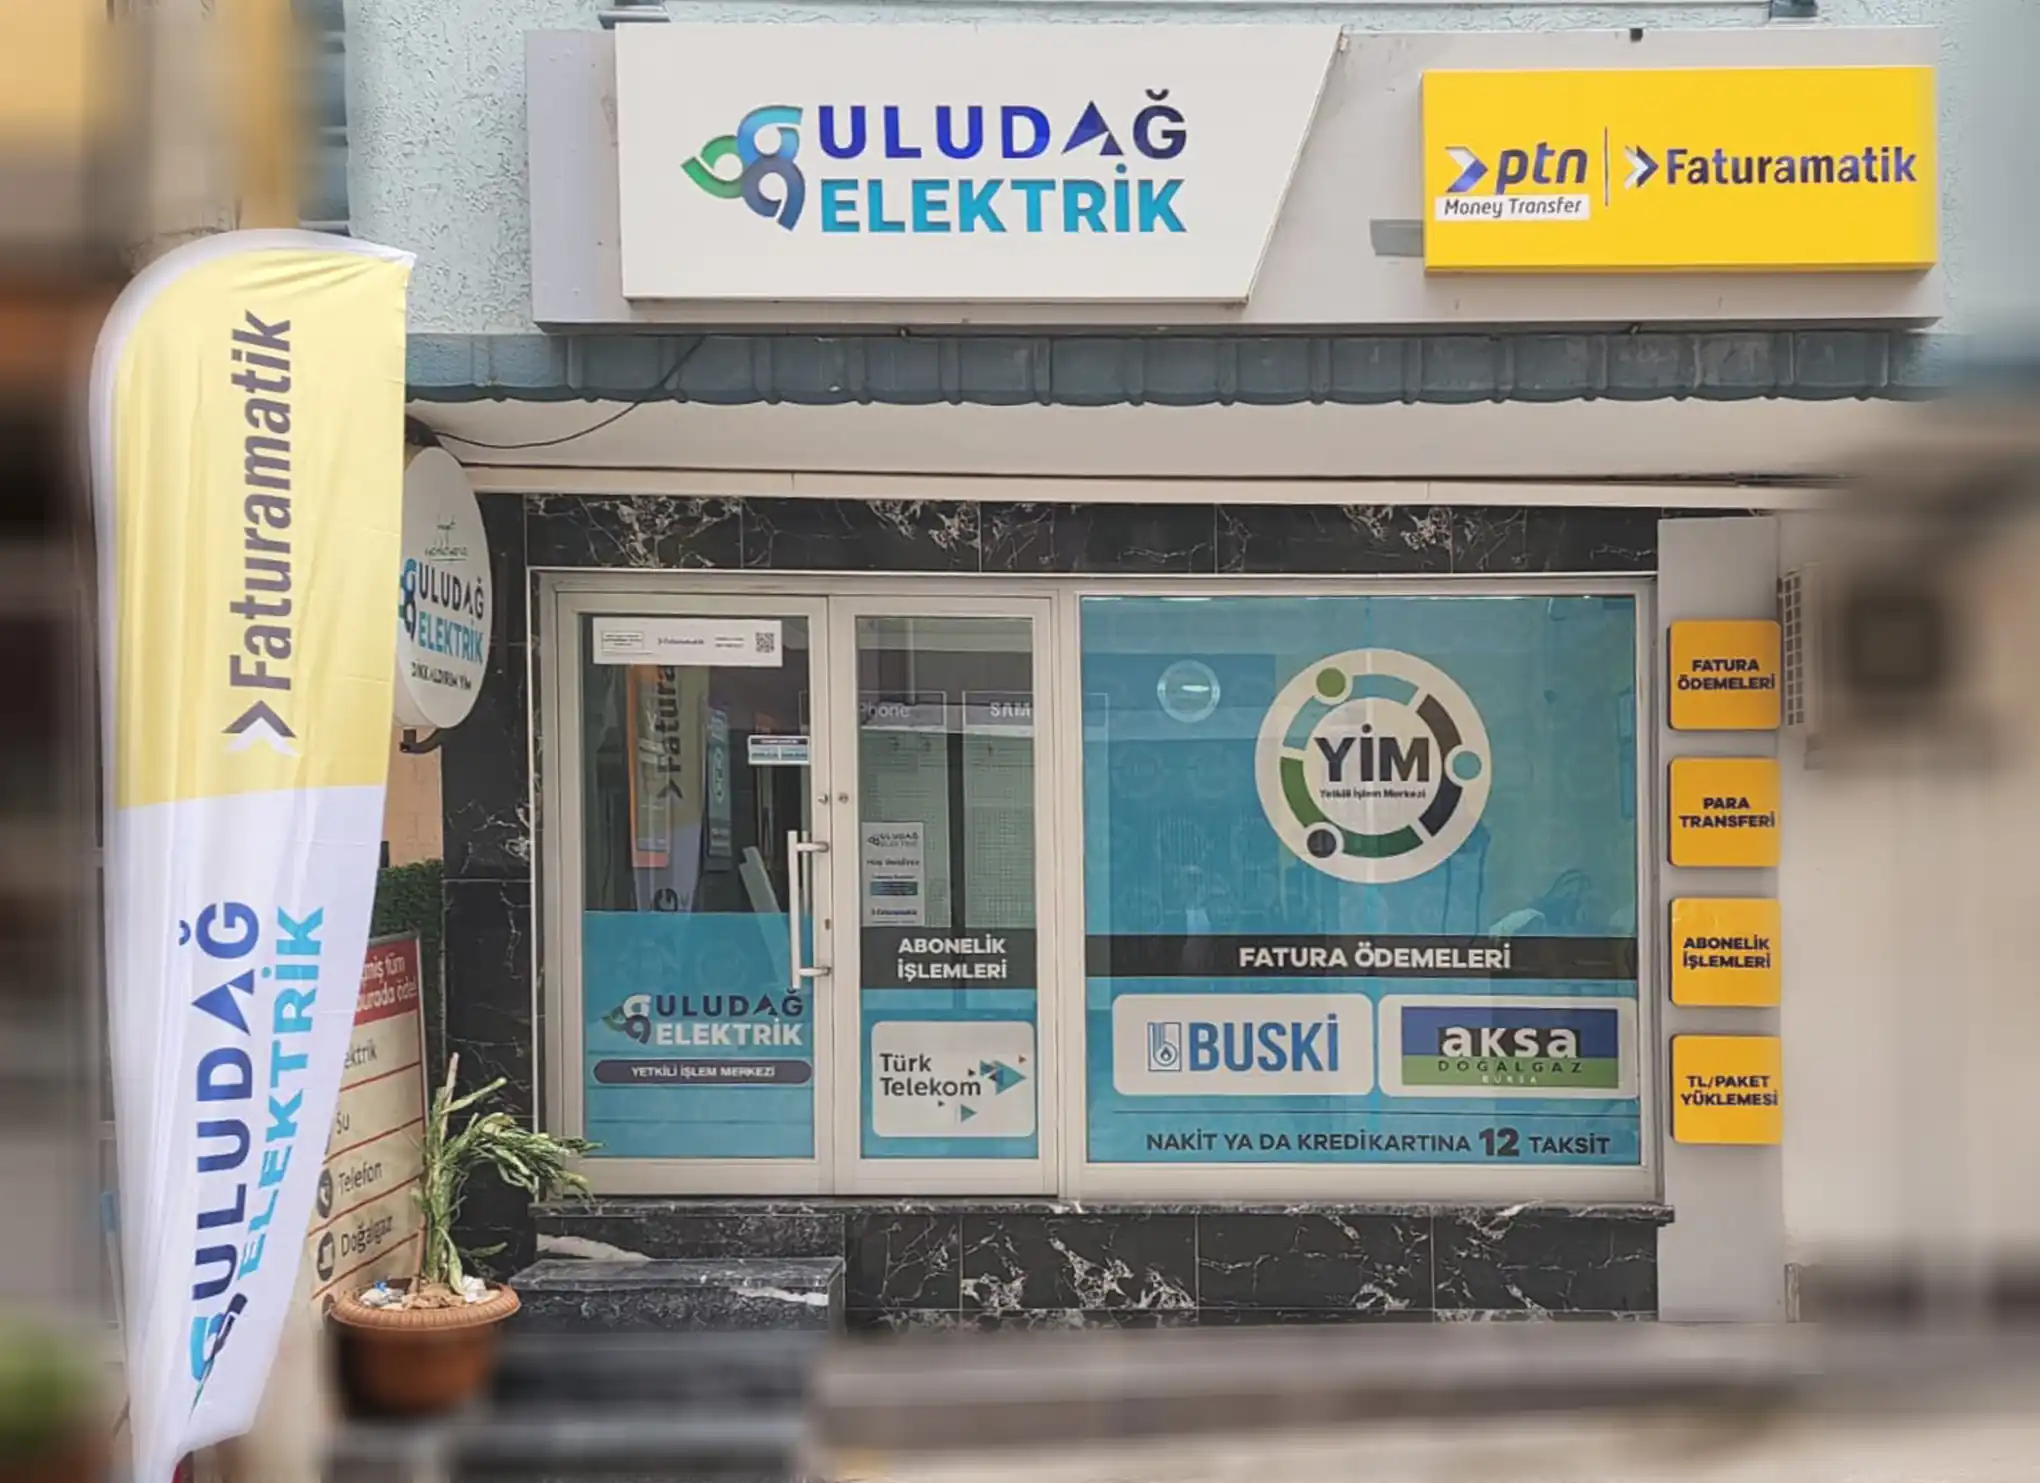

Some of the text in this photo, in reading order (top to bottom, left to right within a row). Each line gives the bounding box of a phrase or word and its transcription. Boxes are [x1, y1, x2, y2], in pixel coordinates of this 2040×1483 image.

[818, 89, 1187, 160] ULUDAĞ
[1495, 142, 1588, 194] ptn
[1666, 146, 1918, 185] Faturamatik
[820, 164, 1188, 233] ELEKTRİK
[1444, 196, 1582, 218] Money Transfer
[229, 309, 293, 691] Faturamatik
[419, 561, 485, 621] ULUDAĞ
[418, 611, 484, 665] ELEKTRİK
[1692, 659, 1760, 672] FATURA
[1677, 673, 1776, 690] ÖDEMELERİ
[1313, 724, 1430, 782] YİM
[1383, 788, 1426, 799] Merkezi
[1703, 797, 1751, 810] PARA
[1679, 811, 1776, 828] TRANSFERİ
[898, 934, 1006, 954] ABONELİK
[1239, 941, 1511, 970] FATURA ÖDEMELERİ
[1683, 934, 1770, 950] ABONELİK
[898, 959, 1007, 982] İŞLEMLERİ
[1682, 952, 1771, 970] İŞLEMLERİ
[656, 988, 804, 1017] ULUDAĞ
[656, 1017, 803, 1046] ELEKTRİK
[1188, 1013, 1339, 1073] BUSKİ
[632, 1064, 775, 1079] YETKİLİ İŞLEM MERKEZİ
[879, 1052, 931, 1073] Türk
[238, 906, 325, 1281] ELEKTRİK
[879, 1076, 982, 1097] Telekom
[1686, 1075, 1771, 1088] TL/PAKET
[178, 901, 260, 1301] ULUDAĞ
[1681, 1089, 1778, 1106] YÜKLEMESİ
[1146, 1128, 1218, 1151] NAKİT
[1223, 1133, 1253, 1151] YA
[1260, 1134, 1292, 1151] DA
[1478, 1127, 1520, 1157] 12
[1528, 1131, 1611, 1155] TAKSİT
[338, 1161, 383, 1195] Telefon
[341, 1215, 394, 1257] Doğalgaz
